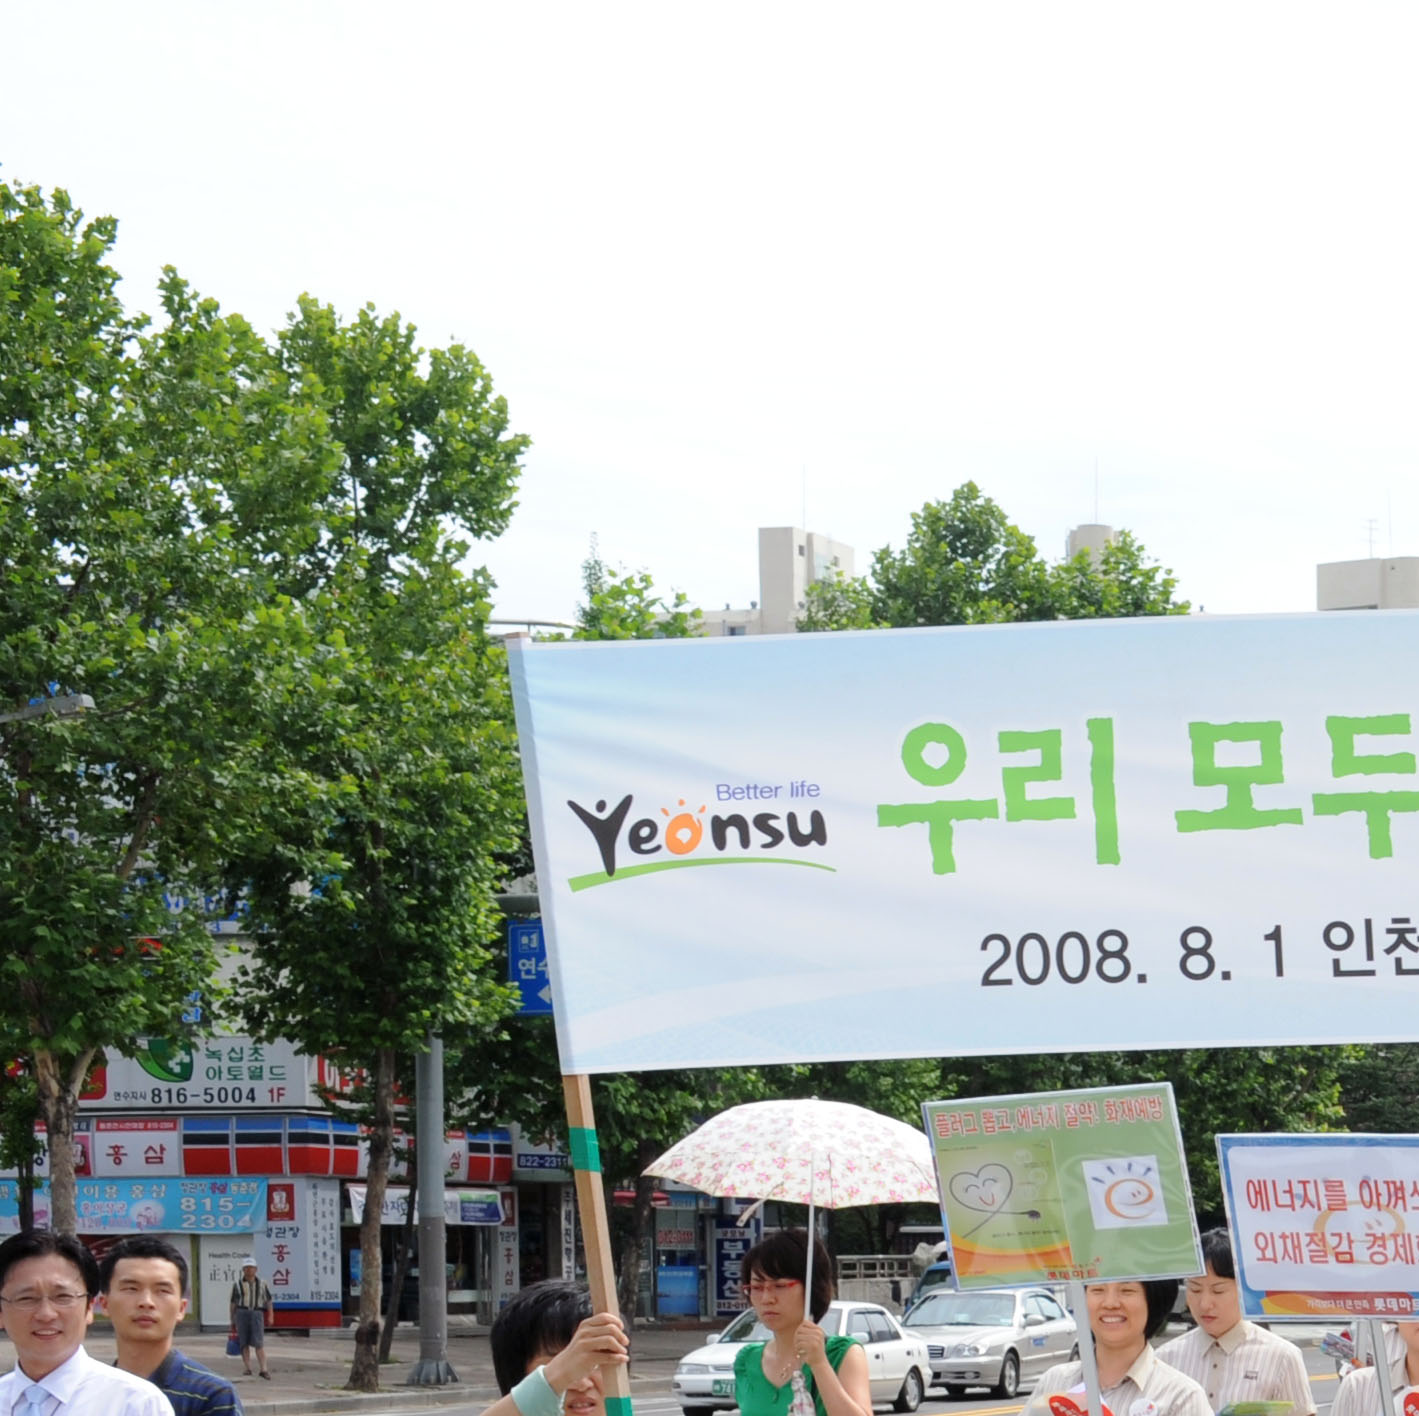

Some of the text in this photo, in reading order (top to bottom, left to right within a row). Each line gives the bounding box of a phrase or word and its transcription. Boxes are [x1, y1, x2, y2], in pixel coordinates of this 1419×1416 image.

[716, 780, 820, 801] Better life
[877, 716, 1121, 875] 우리
[567, 794, 827, 876] Yeonsu
[980, 929, 1148, 988] 2008.
[1178, 925, 1232, 981] 8.
[1263, 924, 1285, 978] 1
[205, 1065, 287, 1081] 아토월드
[151, 1086, 256, 1104] 816-5004
[267, 1086, 286, 1103] 1F
[934, 1111, 978, 1139] 플러그
[1104, 1096, 1164, 1124] 화재예방
[1245, 1178, 1348, 1213] 에너지를
[181, 1214, 253, 1228] 2304
[1254, 1230, 1356, 1265] 외채절감
